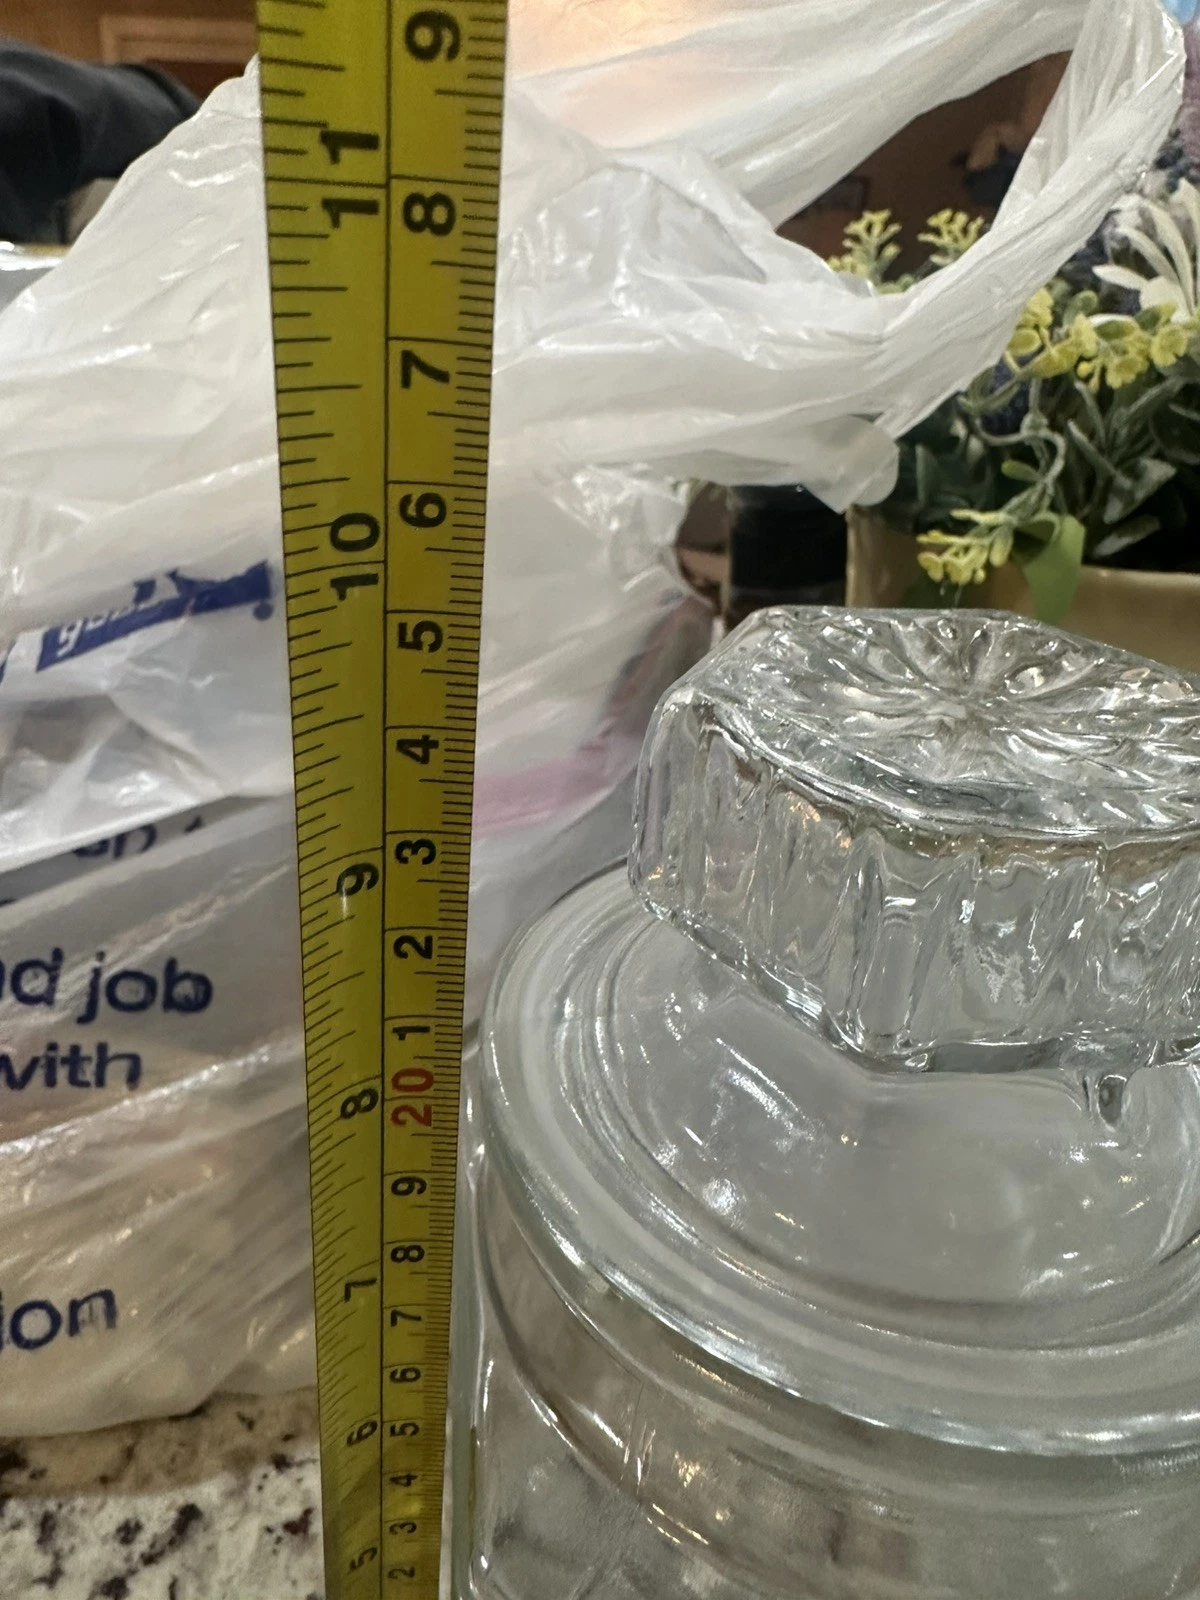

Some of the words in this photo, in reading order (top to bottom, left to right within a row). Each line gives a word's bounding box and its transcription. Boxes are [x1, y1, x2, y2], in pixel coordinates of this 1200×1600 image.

[404, 10, 461, 62] 9
[319, 130, 380, 228] 11
[403, 192, 456, 236] 8
[401, 350, 449, 389] 7
[399, 492, 447, 528] 6
[330, 512, 380, 600] 10
[398, 620, 443, 653] 5
[396, 735, 439, 764] 4
[394, 838, 437, 865] 3
[336, 862, 379, 897] 9
[393, 935, 433, 960] 2
[0, 948, 64, 1005] d
[76, 950, 213, 1024] job
[392, 1026, 431, 1041] 1
[340, 1088, 379, 1119] 8
[390, 1068, 434, 1127] 20
[391, 1176, 427, 1196] 9
[390, 1244, 425, 1263] 8
[344, 1278, 378, 1303] 7
[0, 1288, 117, 1351] on
[390, 1309, 422, 1327] 7
[389, 1367, 421, 1384] 6
[346, 1421, 378, 1446] 6
[389, 1422, 419, 1437] 5
[389, 1473, 418, 1487] 4
[389, 1522, 417, 1535] 3
[350, 1546, 378, 1571] 5
[387, 1566, 415, 1580] 2
